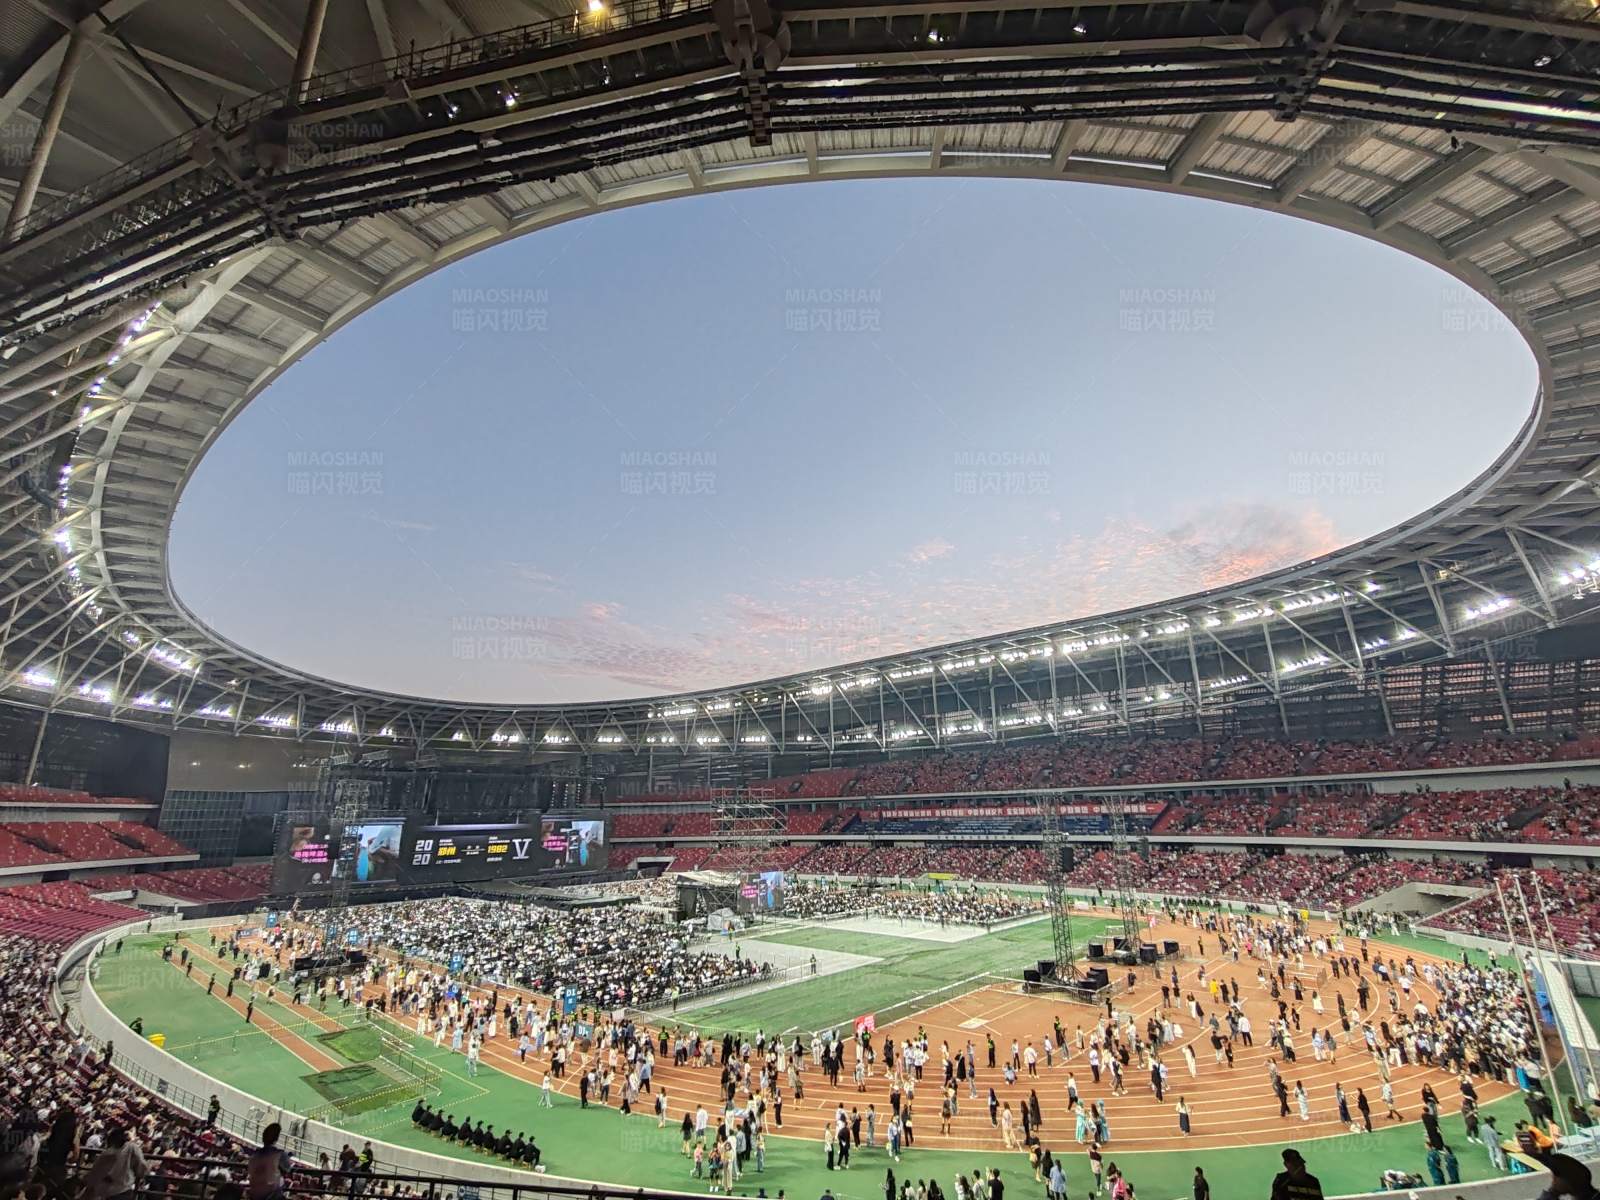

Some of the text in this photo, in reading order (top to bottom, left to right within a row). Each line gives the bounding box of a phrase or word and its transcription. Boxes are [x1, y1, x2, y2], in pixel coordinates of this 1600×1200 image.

[416, 840, 433, 852] 20
[488, 845, 508, 854] 1982
[412, 854, 431, 866] 20
